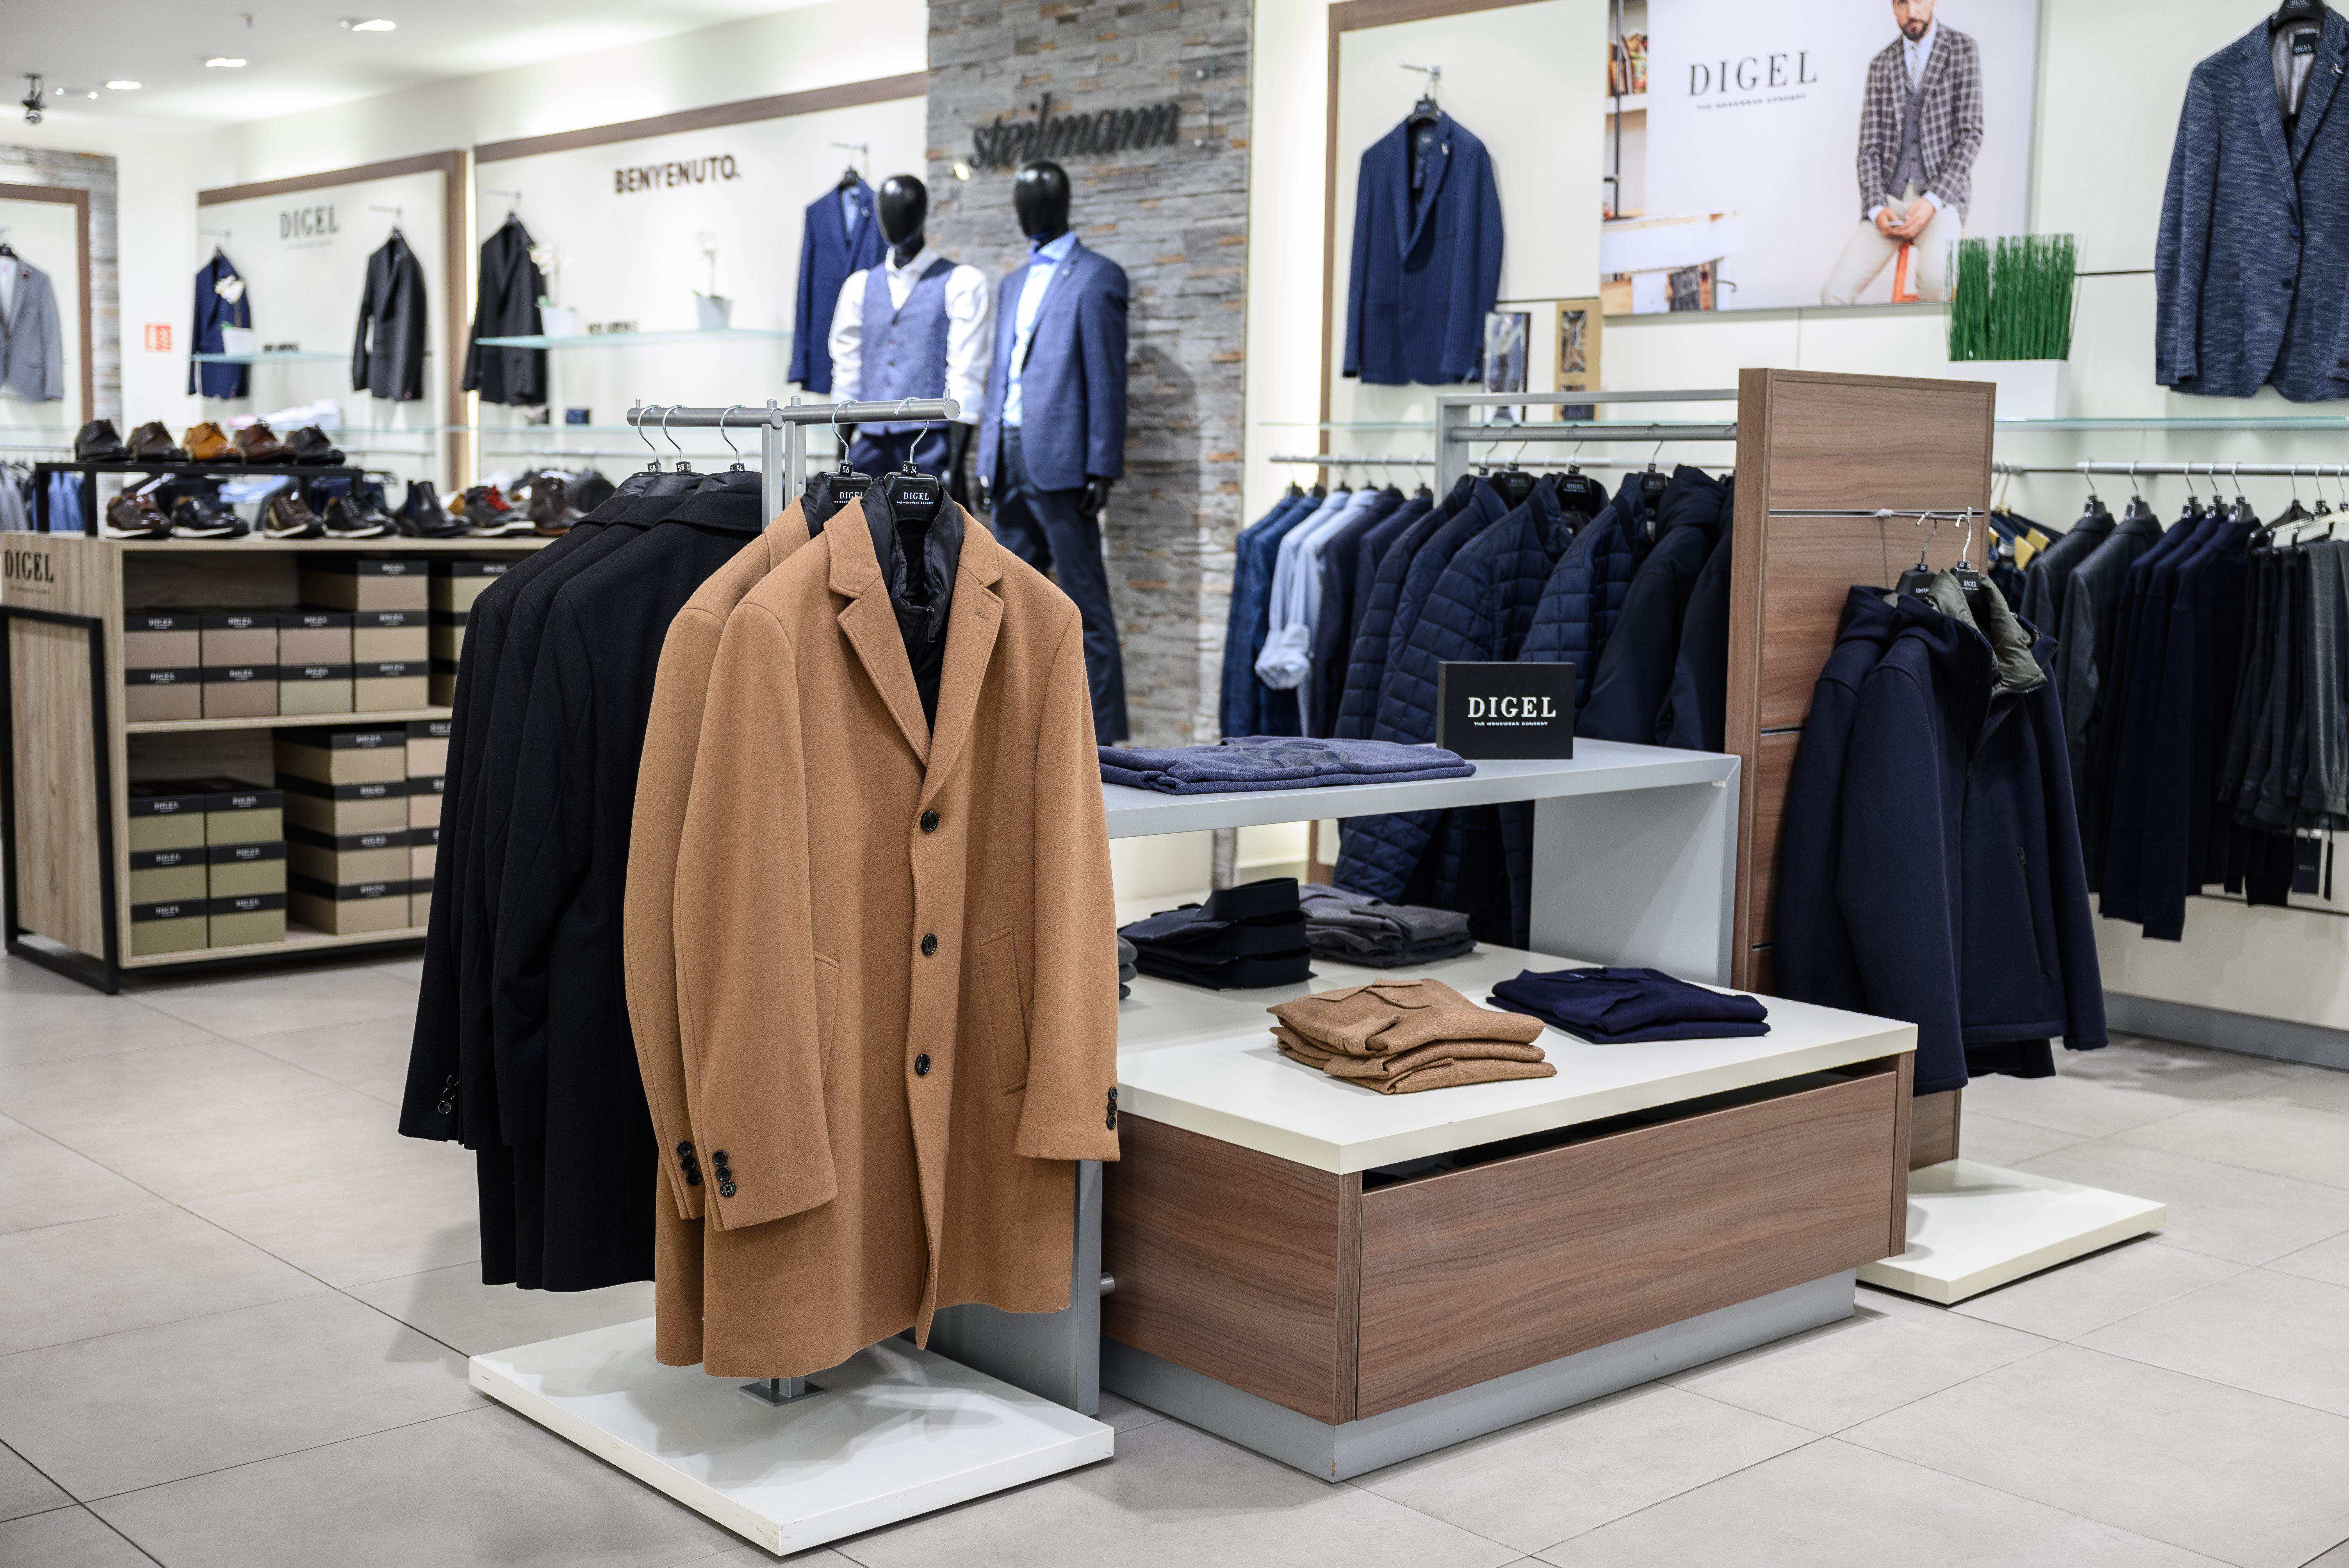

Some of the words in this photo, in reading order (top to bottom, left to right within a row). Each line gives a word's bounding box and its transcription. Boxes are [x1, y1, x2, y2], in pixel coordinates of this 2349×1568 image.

[1688, 51, 1818, 97] DIGEL
[280, 204, 340, 240] DIGEL
[903, 464, 908, 472] 54
[903, 492, 929, 500] DIGEL
[4, 548, 54, 583] DIGEL
[1468, 697, 1556, 717] DIGEL
